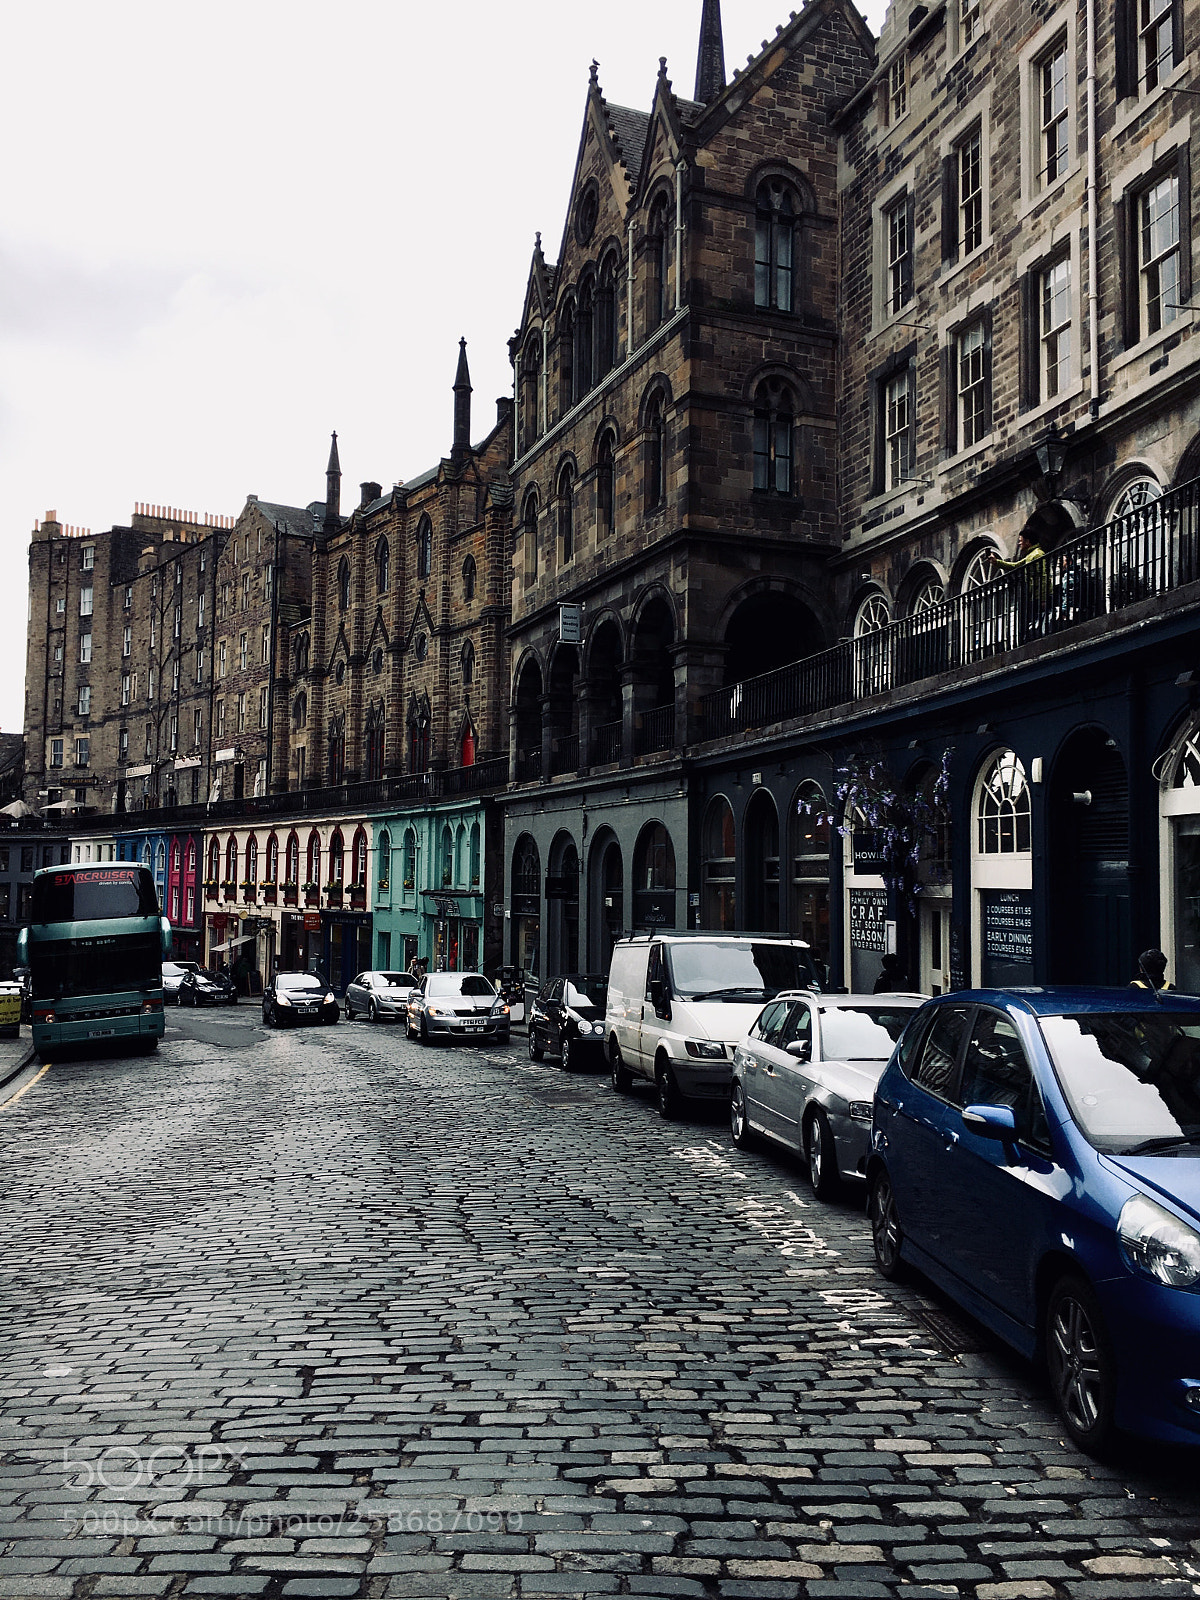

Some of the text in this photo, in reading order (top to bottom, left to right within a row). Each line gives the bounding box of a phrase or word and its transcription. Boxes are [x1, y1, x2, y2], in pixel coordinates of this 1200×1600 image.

[855, 851, 885, 859] HOWIE
[54, 871, 134, 884] STARCRUISER
[851, 897, 869, 905] FAMILY
[999, 893, 1020, 902] LUNCH
[851, 905, 884, 921] CRAF
[990, 905, 1014, 914] COURSES
[851, 919, 862, 928] EAT
[991, 917, 1015, 926] COURSES
[987, 931, 1032, 945] EARLY DINING
[851, 940, 885, 951] INDEPENDE
[991, 943, 1015, 953] COURSES
